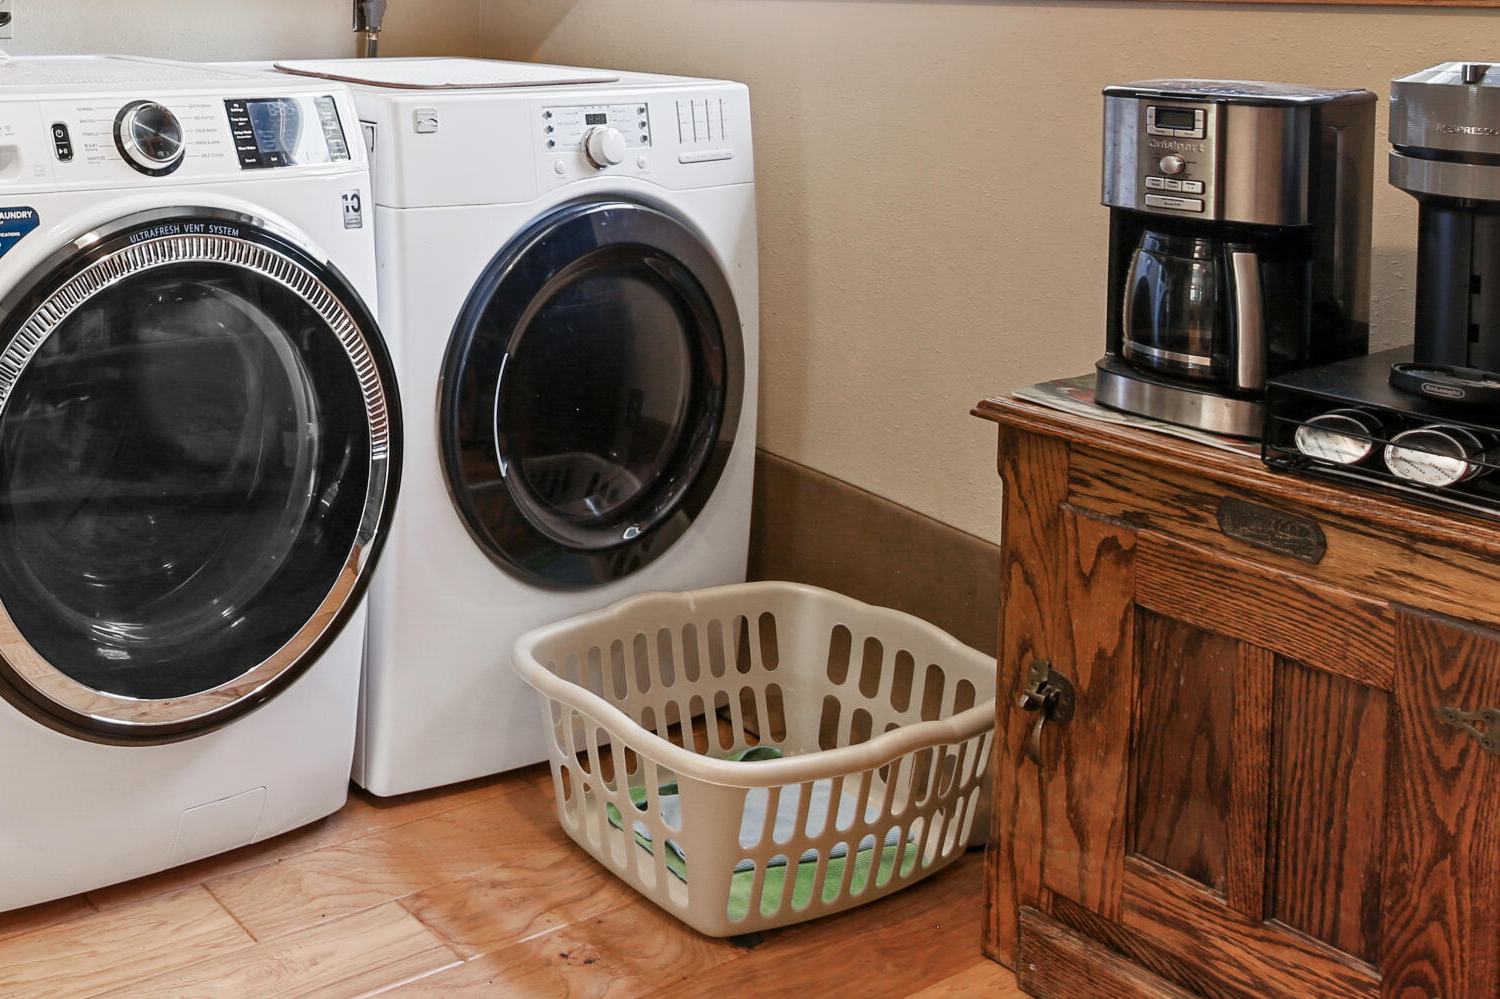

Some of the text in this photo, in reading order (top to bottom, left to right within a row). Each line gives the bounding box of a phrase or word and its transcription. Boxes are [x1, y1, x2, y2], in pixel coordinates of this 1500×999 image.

[1148, 138, 1205, 153] Cuisinart
[129, 224, 239, 243] ULTRAFRESH VENT SYSTEM
